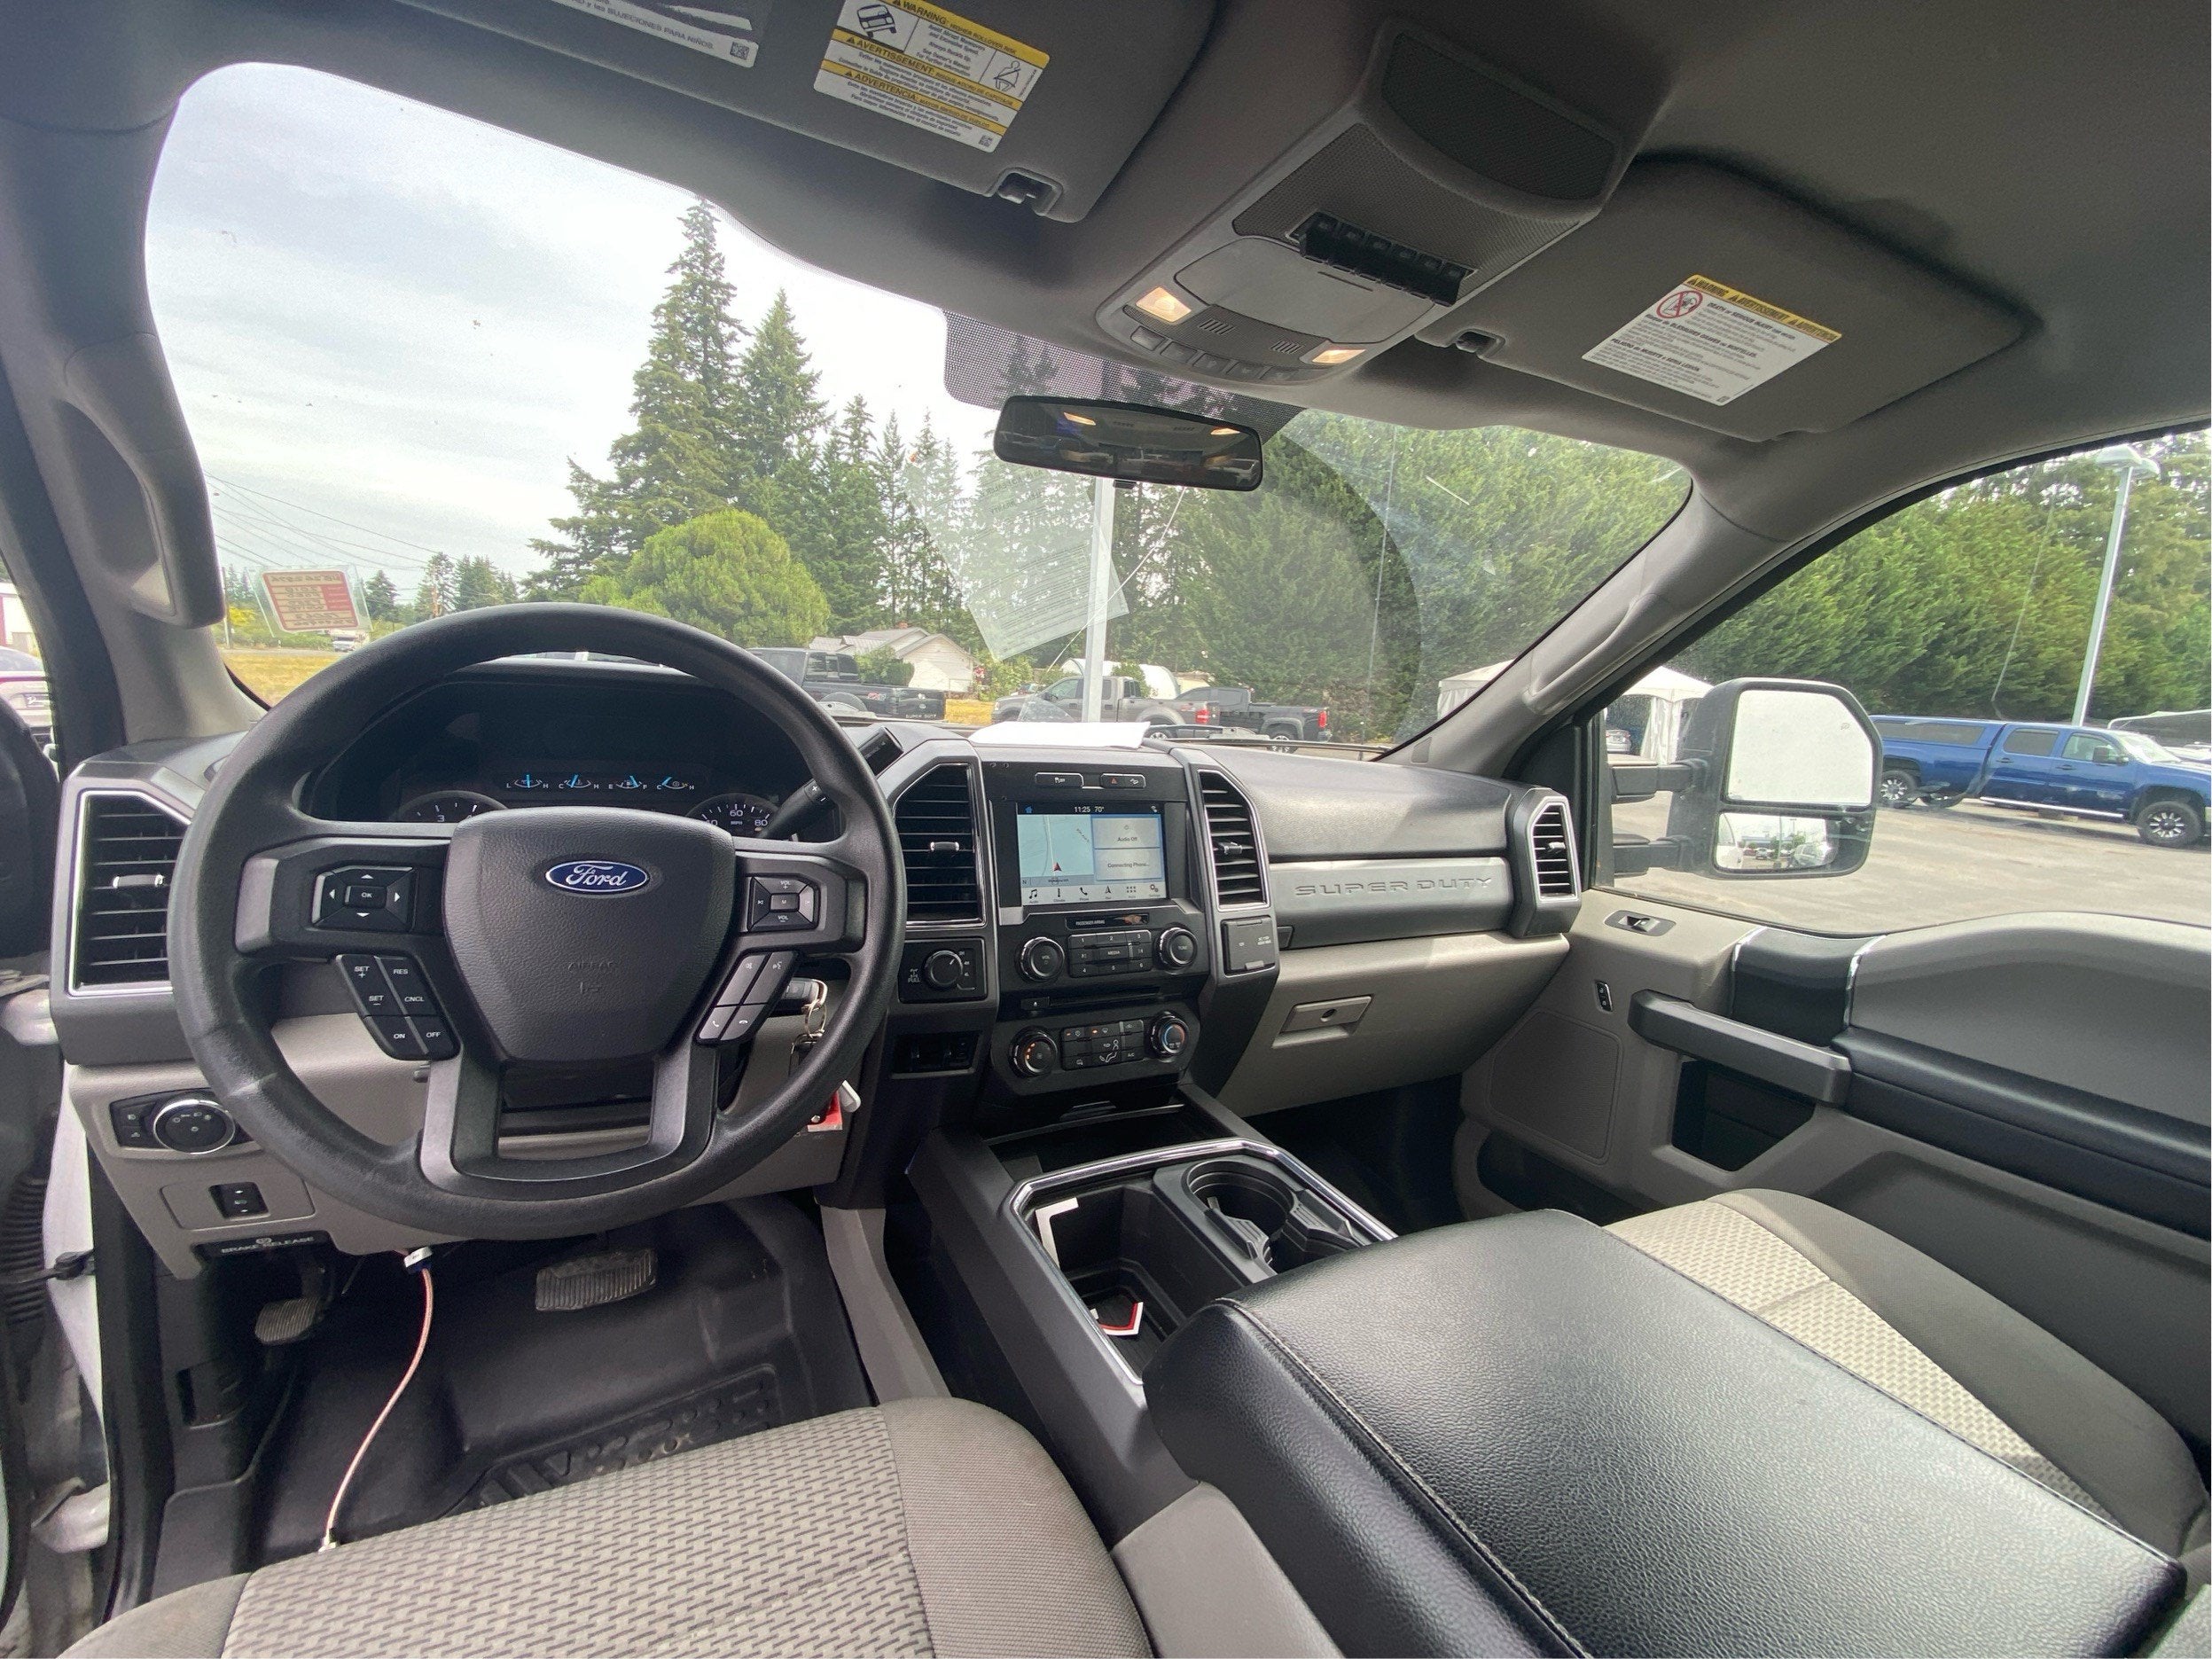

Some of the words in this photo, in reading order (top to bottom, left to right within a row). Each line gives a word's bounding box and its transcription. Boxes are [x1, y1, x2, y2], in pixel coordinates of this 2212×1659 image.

[663, 27, 685, 40] PARA
[566, 864, 629, 886] Ford
[1295, 880, 1408, 896] SUPER
[1418, 877, 1491, 889] DUTY
